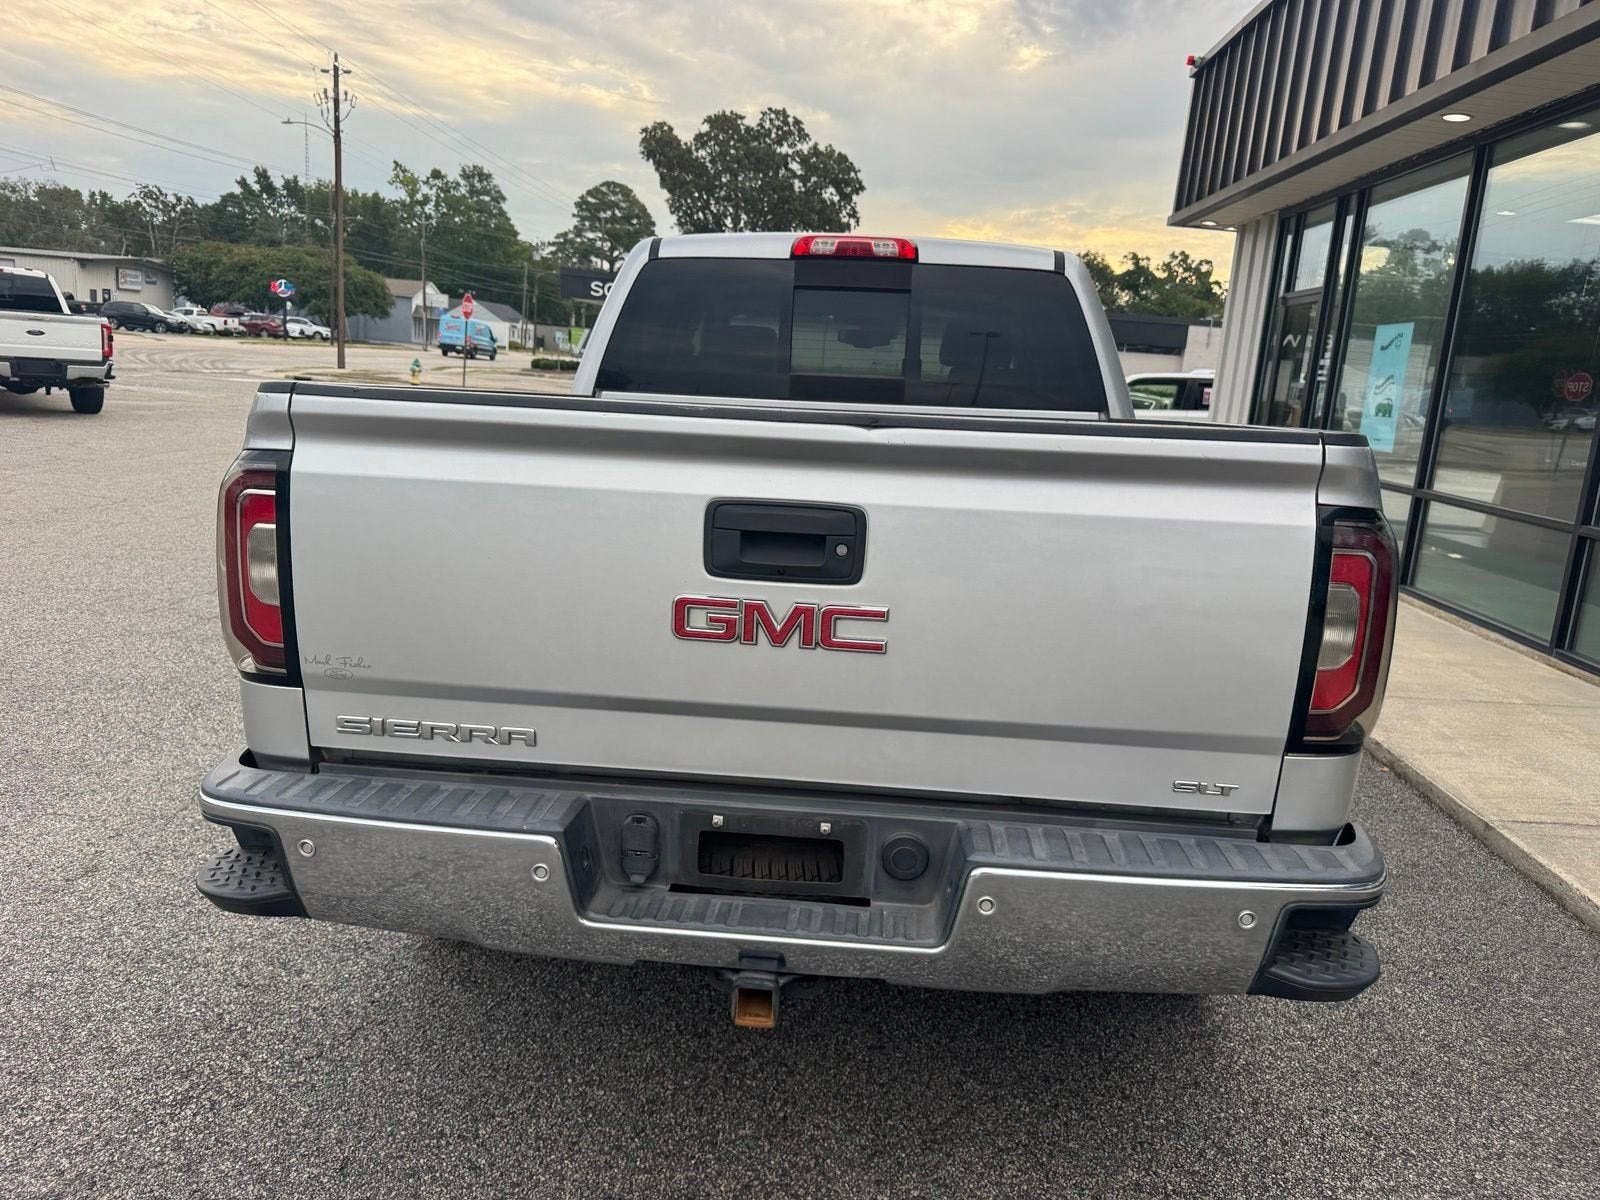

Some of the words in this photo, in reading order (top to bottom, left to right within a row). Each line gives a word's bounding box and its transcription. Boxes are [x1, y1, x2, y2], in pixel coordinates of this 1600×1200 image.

[672, 593, 890, 655] GMC
[336, 714, 537, 747] SIERRA
[1172, 780, 1239, 797] SLT
